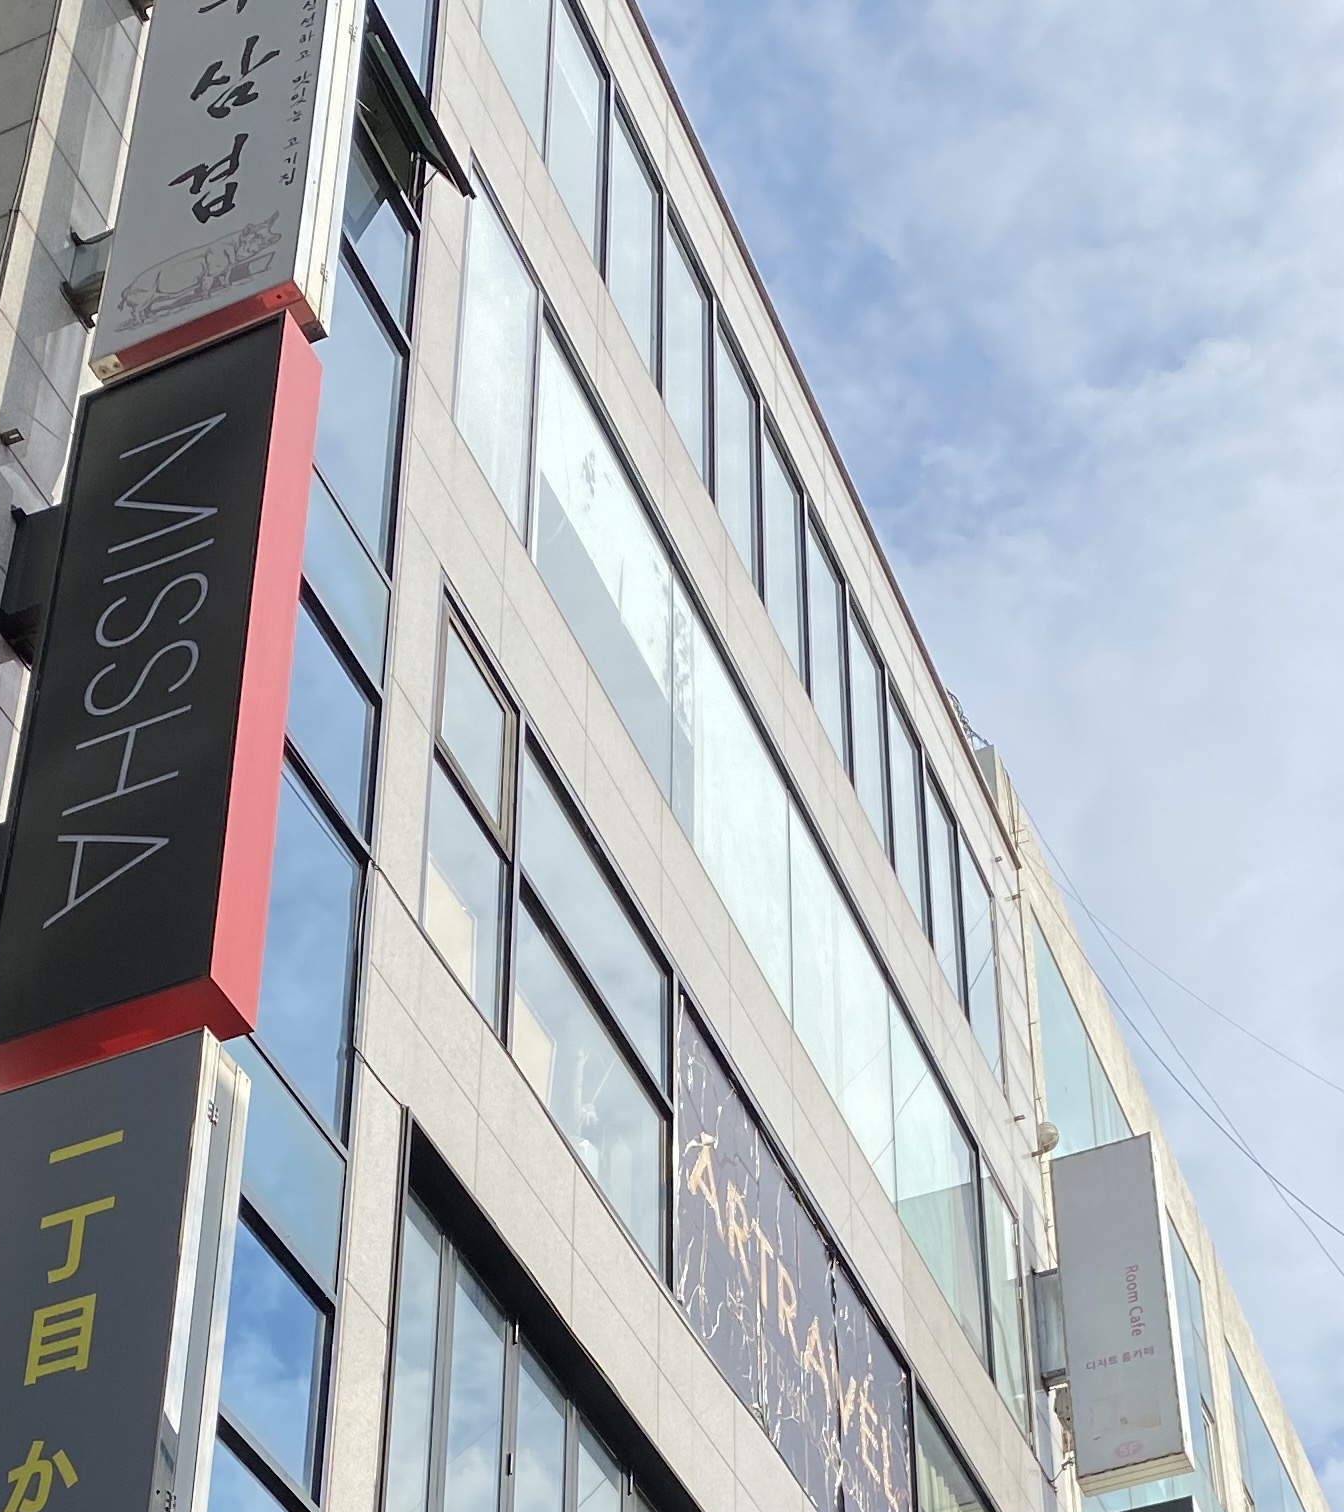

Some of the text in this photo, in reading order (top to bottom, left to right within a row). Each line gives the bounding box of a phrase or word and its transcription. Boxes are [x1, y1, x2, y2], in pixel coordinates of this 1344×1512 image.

[168, 0, 281, 224] 삼겹
[43, 411, 227, 930] MISSHA
[23, 1128, 126, 1388] 一丁目
[1124, 1263, 1147, 1337] Room Cafe
